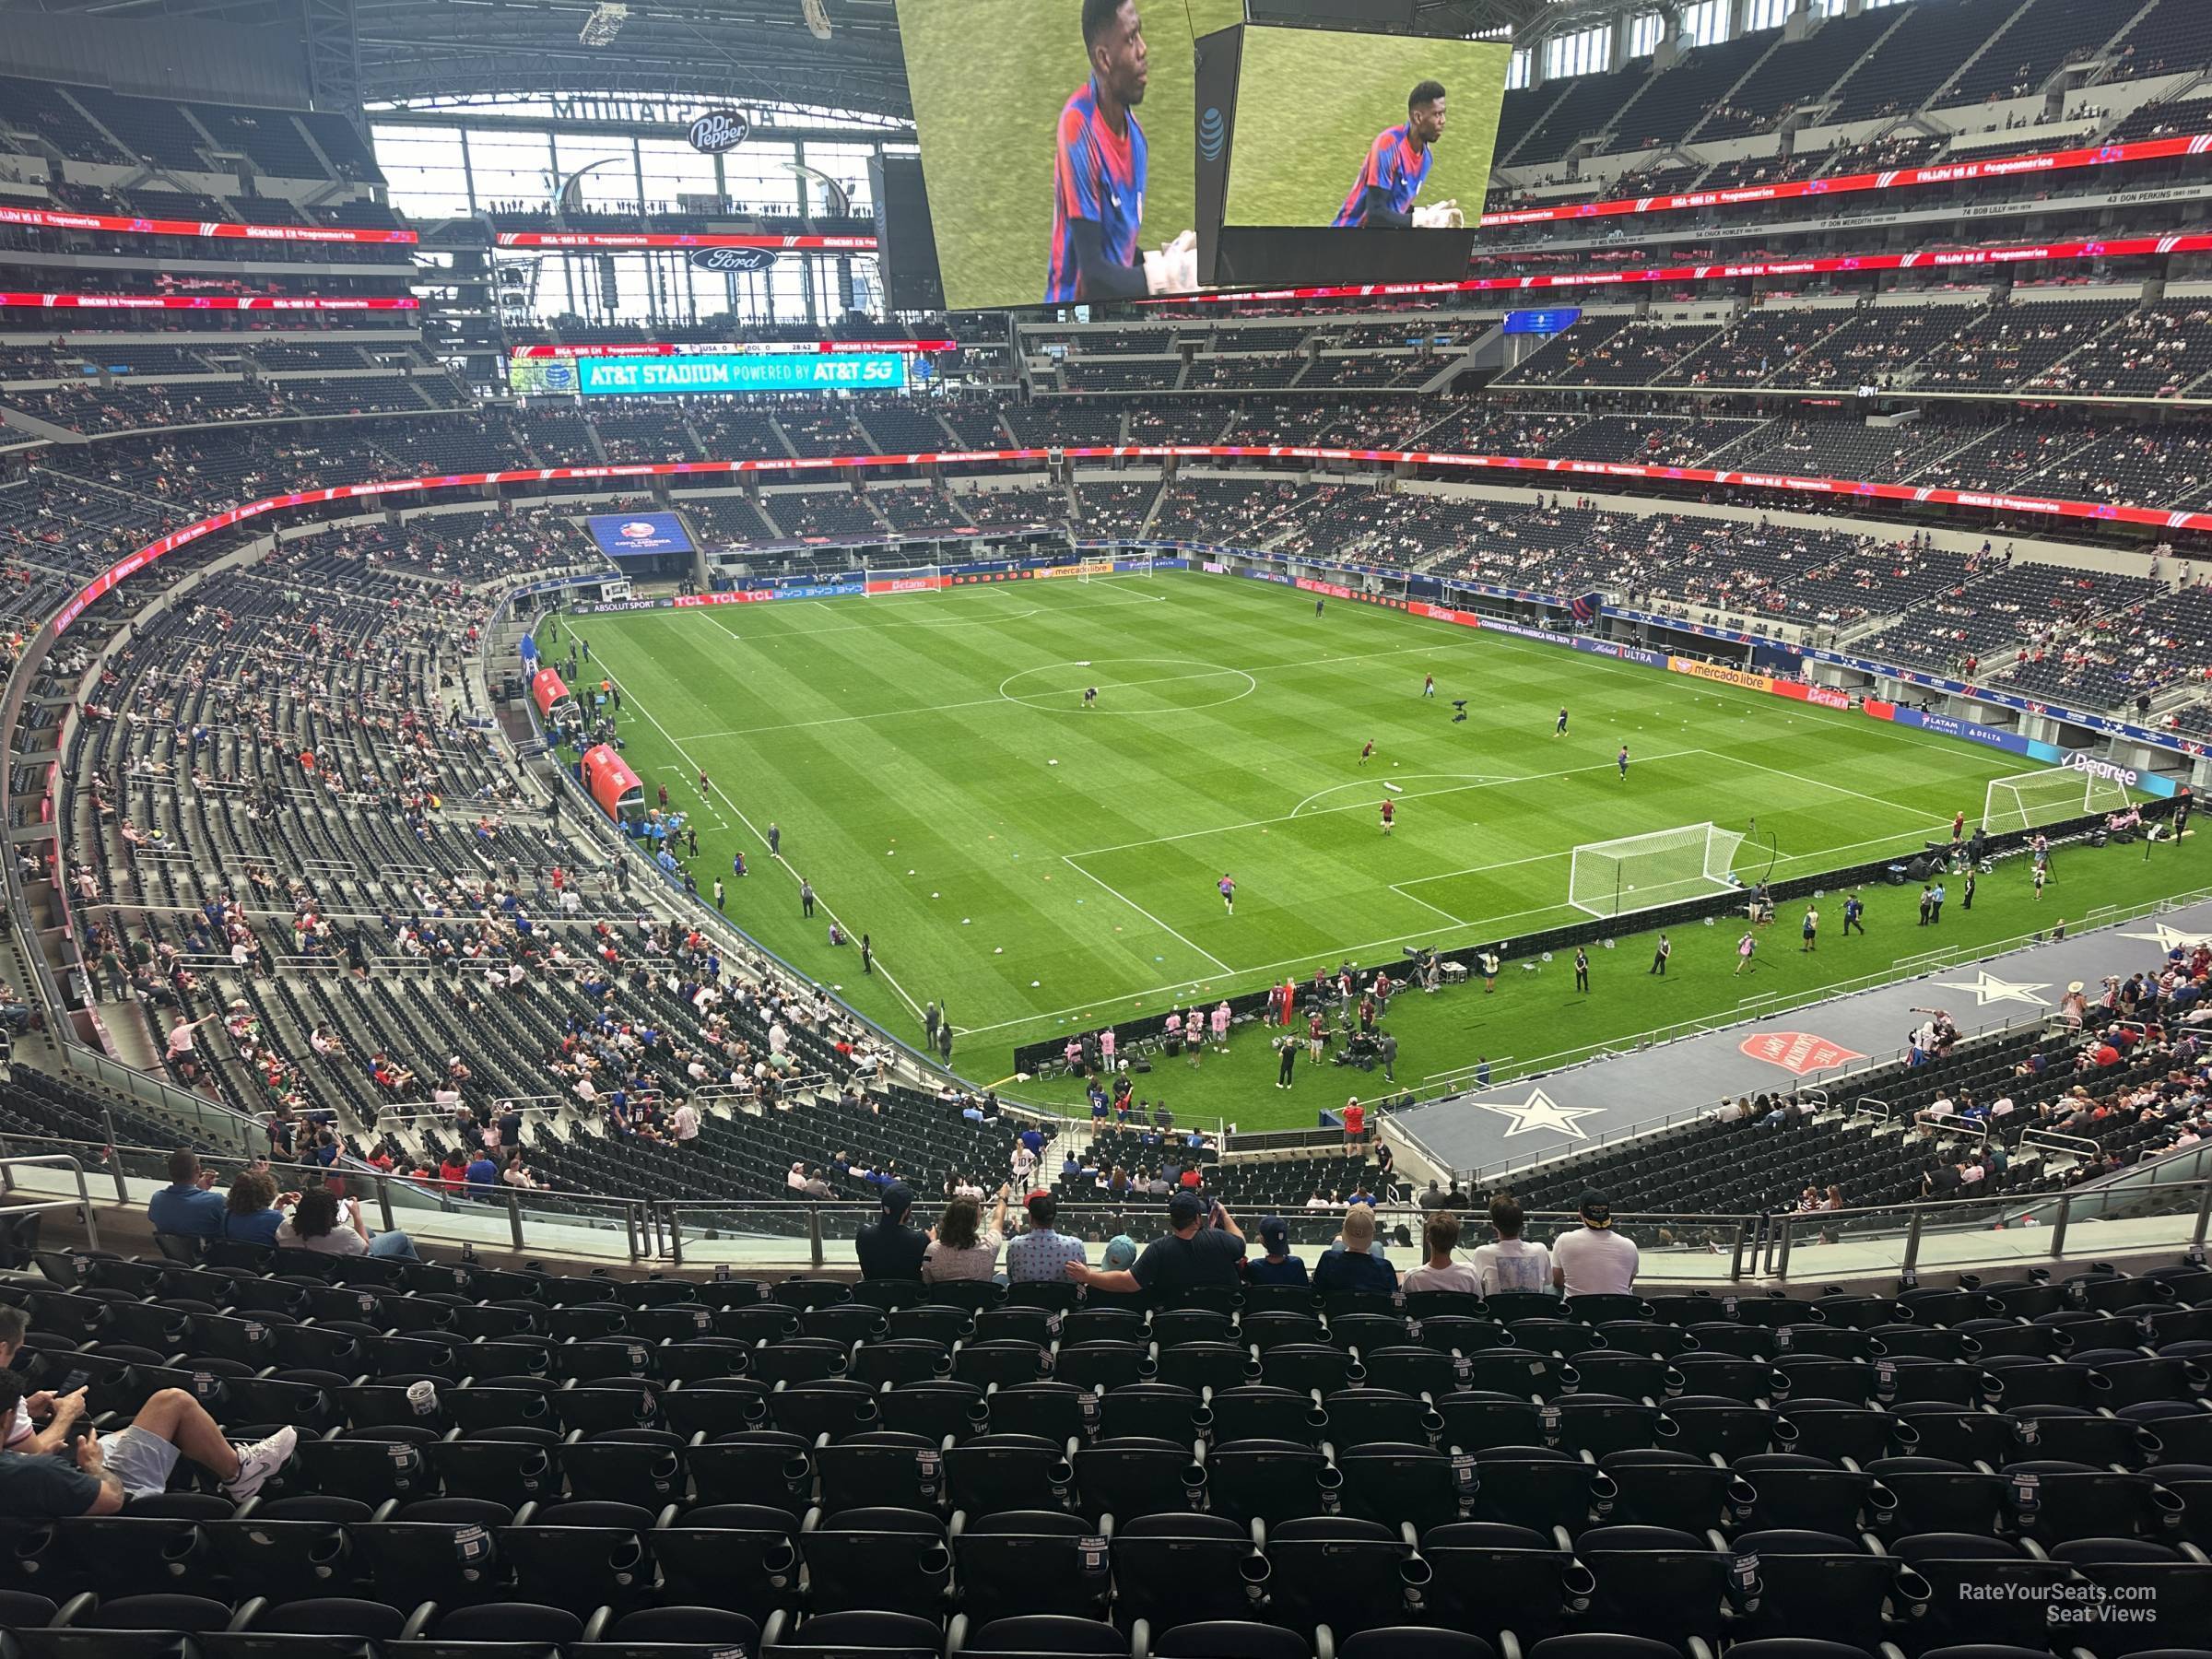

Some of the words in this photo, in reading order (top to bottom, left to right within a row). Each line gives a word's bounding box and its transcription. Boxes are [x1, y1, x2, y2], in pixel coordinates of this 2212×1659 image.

[712, 115, 734, 133] Dr
[697, 118, 745, 147] Pepper
[1917, 169, 1952, 182] FOLLOW
[1954, 167, 1965, 178] US
[1967, 165, 1978, 176] AT
[2120, 193, 2136, 202] DON
[2139, 191, 2171, 201] PERKINS
[1973, 207, 1988, 216] BOB
[1989, 206, 2006, 214] LILLY
[1842, 218, 1872, 227] MEREDITH
[708, 250, 759, 268] Ford
[1935, 254, 1963, 264] FOLLOW
[1965, 253, 1975, 262] US
[1976, 252, 1985, 261] AT
[590, 366, 639, 385] AT&T
[643, 363, 729, 384] STADIUM
[733, 364, 792, 382] POWERED
[795, 364, 810, 380] BY
[813, 362, 861, 381] AT&T
[863, 361, 893, 380] 5G
[1055, 564, 1091, 576] mercado
[1091, 564, 1107, 572] libre
[1273, 573, 1288, 583] ULTRA
[745, 591, 773, 601] TCL
[806, 588, 833, 596] BYD
[677, 596, 705, 607] TCL
[713, 594, 739, 604] TCL
[594, 602, 629, 612] ABSOLUT
[629, 600, 655, 609] SPORT
[1508, 624, 1522, 634] COPA
[1624, 650, 1653, 664] ULTRA
[1695, 665, 1739, 683] mercado
[1740, 672, 1764, 688] libre
[1930, 718, 1959, 729] LATAM
[1977, 730, 2001, 743] DELTA
[2074, 753, 2136, 786] Degree
[1761, 1035, 1788, 1060] ARMY
[1814, 1047, 1838, 1065] THE
[1094, 1100, 1102, 1109] 10
[1018, 1158, 1028, 1169] 10
